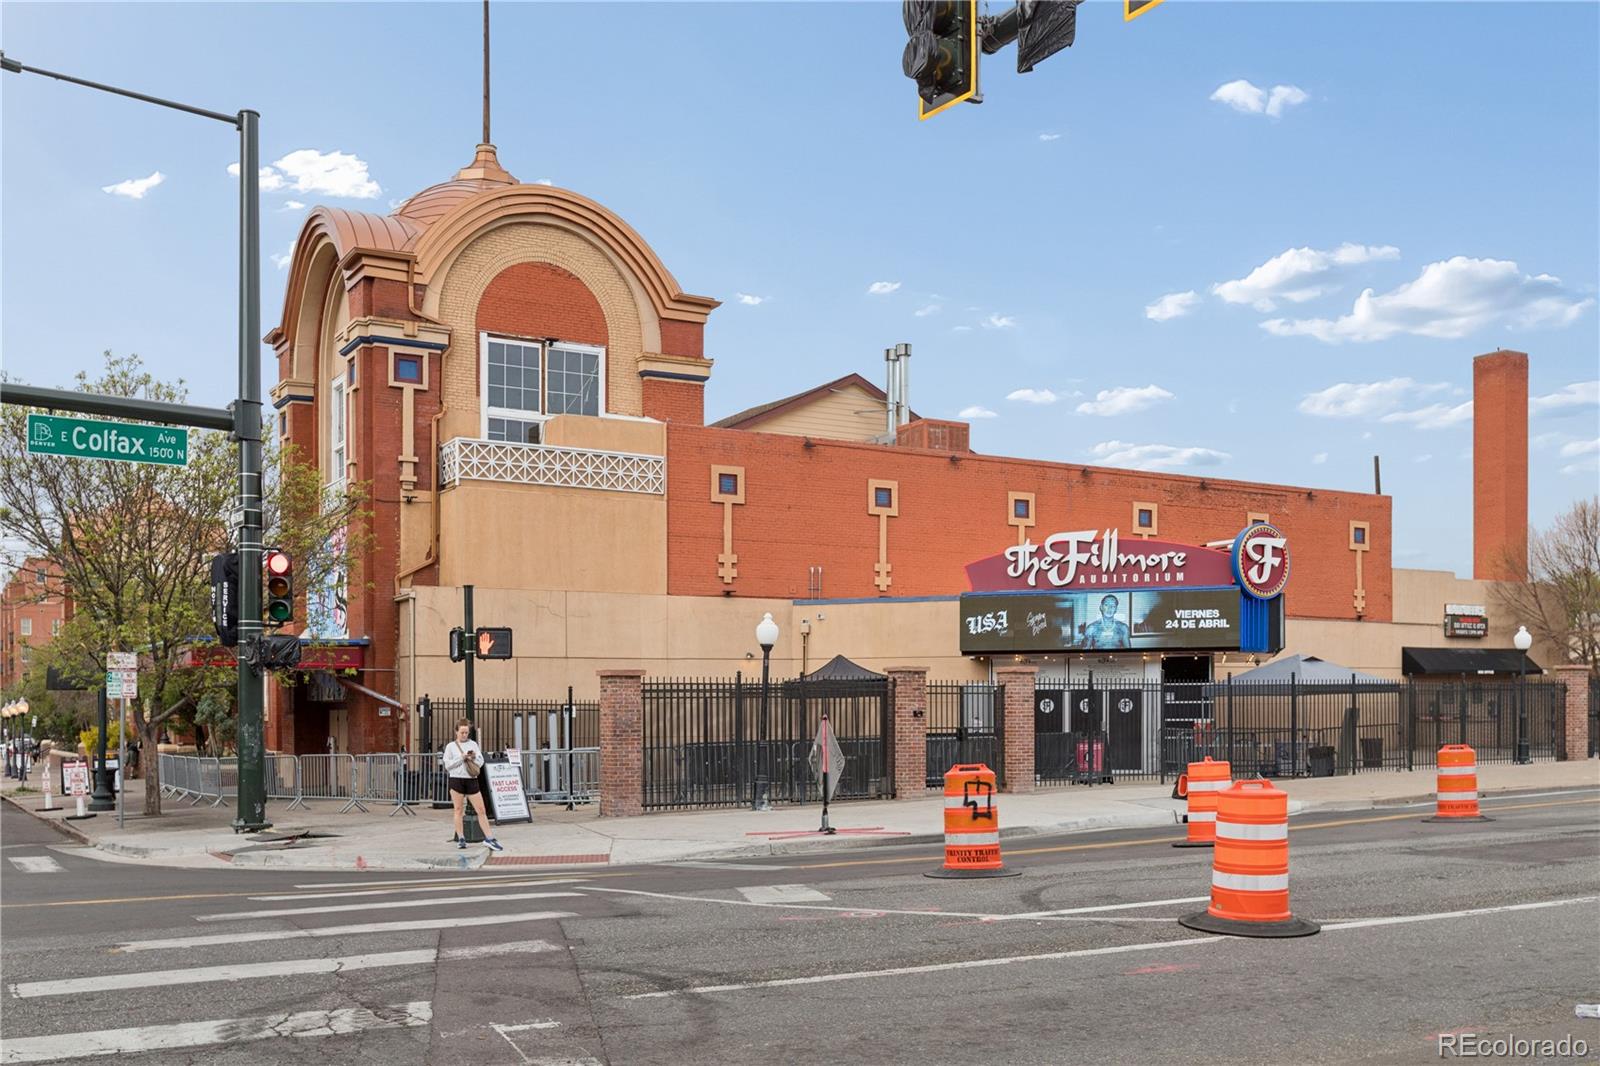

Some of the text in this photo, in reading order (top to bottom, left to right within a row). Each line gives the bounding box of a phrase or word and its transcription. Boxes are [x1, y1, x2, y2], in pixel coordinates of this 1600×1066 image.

[61, 426, 177, 455] E Colfax Ave
[149, 447, 184, 459] 1500 N
[1004, 528, 1187, 587] The Fillmore
[1246, 536, 1287, 584] F
[1080, 572, 1184, 583] AUDITORIUM
[965, 610, 1008, 635] USA
[1174, 609, 1220, 618] VIERNES
[1165, 619, 1230, 628] 24 DE ABRIL
